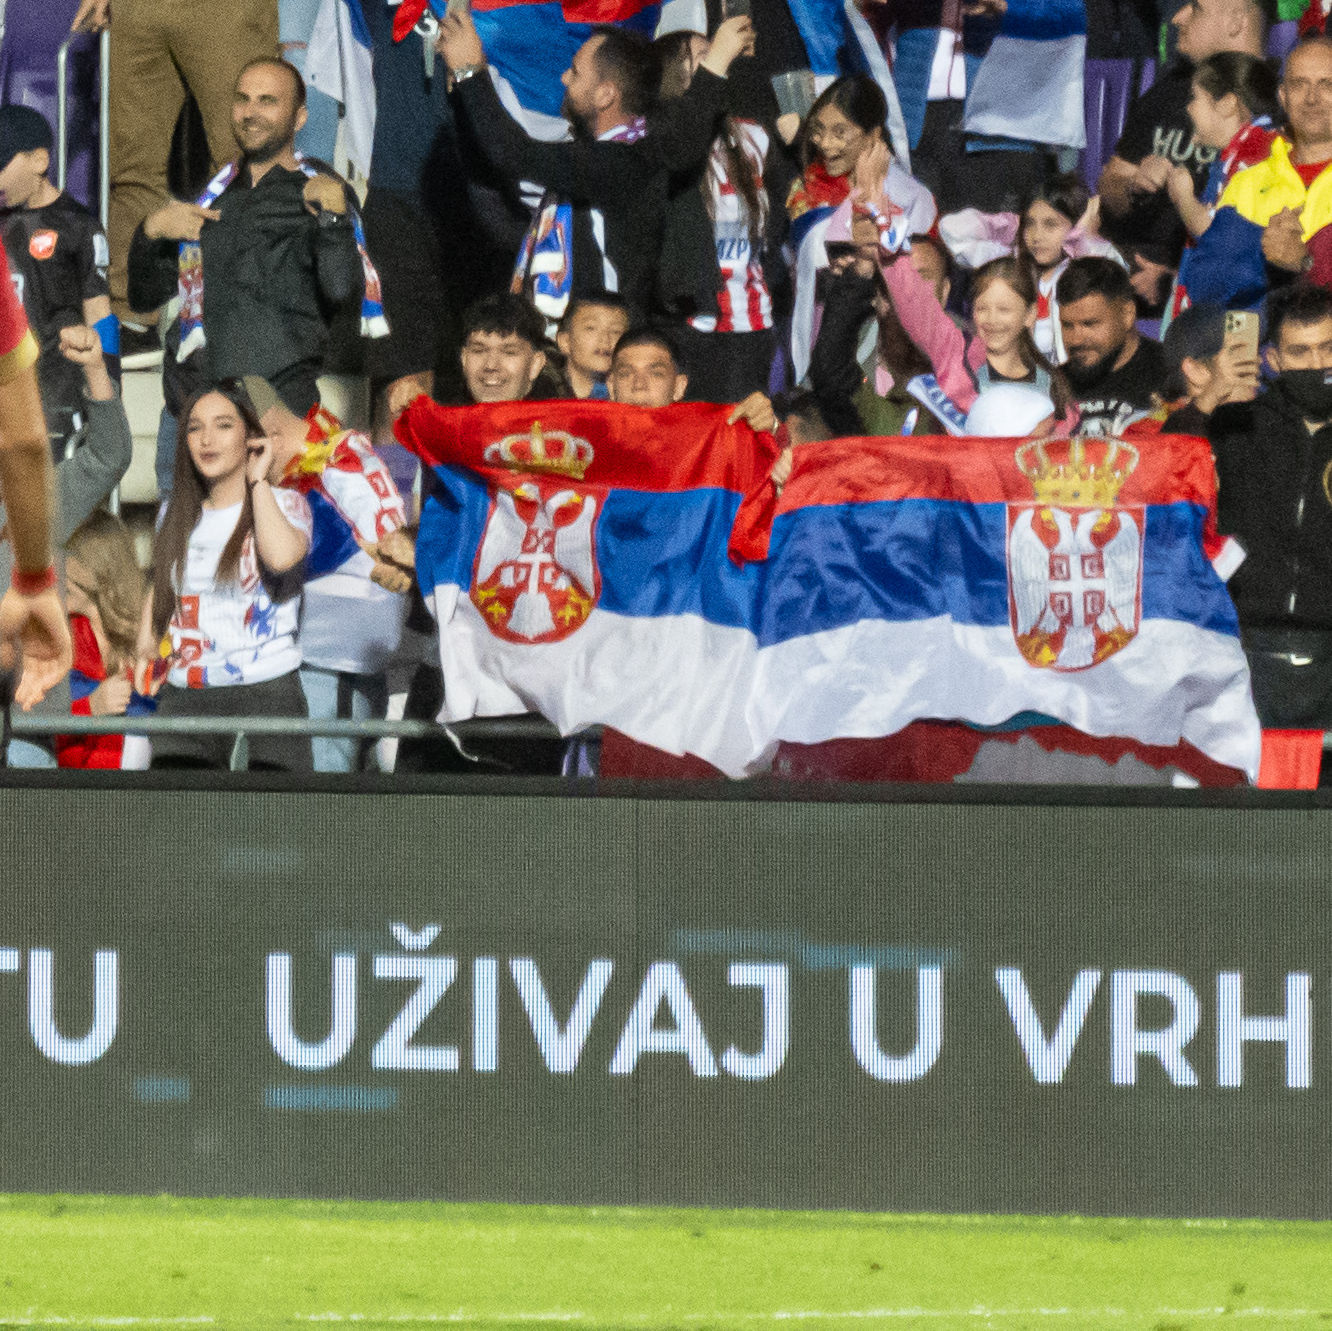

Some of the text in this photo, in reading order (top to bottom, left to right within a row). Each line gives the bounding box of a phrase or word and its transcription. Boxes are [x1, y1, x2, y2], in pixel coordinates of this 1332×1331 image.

[266, 922, 1313, 1088] UŽIVAJ U VRH
